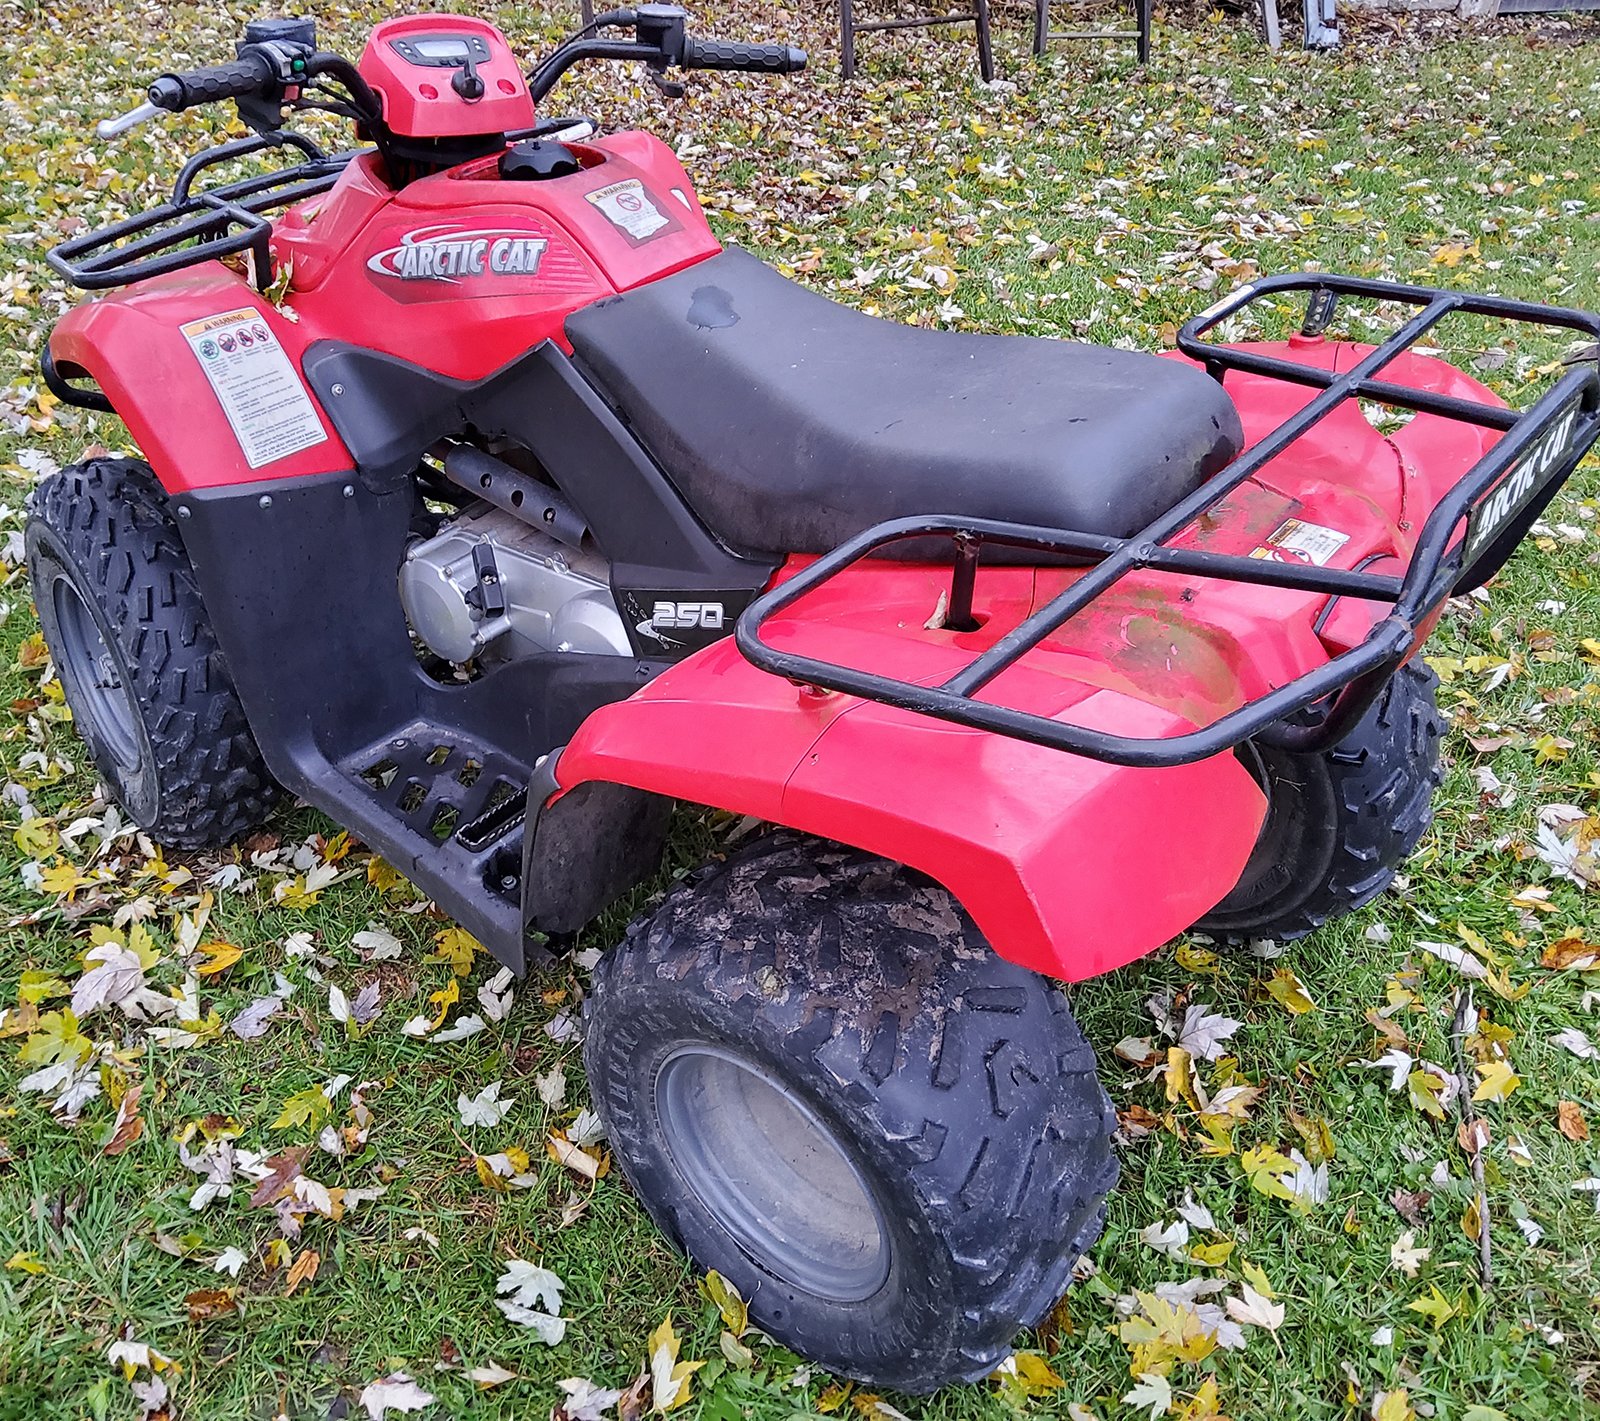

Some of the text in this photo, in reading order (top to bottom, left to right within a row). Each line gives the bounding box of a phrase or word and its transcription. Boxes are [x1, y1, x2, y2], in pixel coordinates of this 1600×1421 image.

[400, 238, 548, 280] ARCTIC CAT
[211, 313, 245, 328] WARNING
[1478, 410, 1576, 534] ARCTIC CAT
[652, 601, 724, 629] 250
